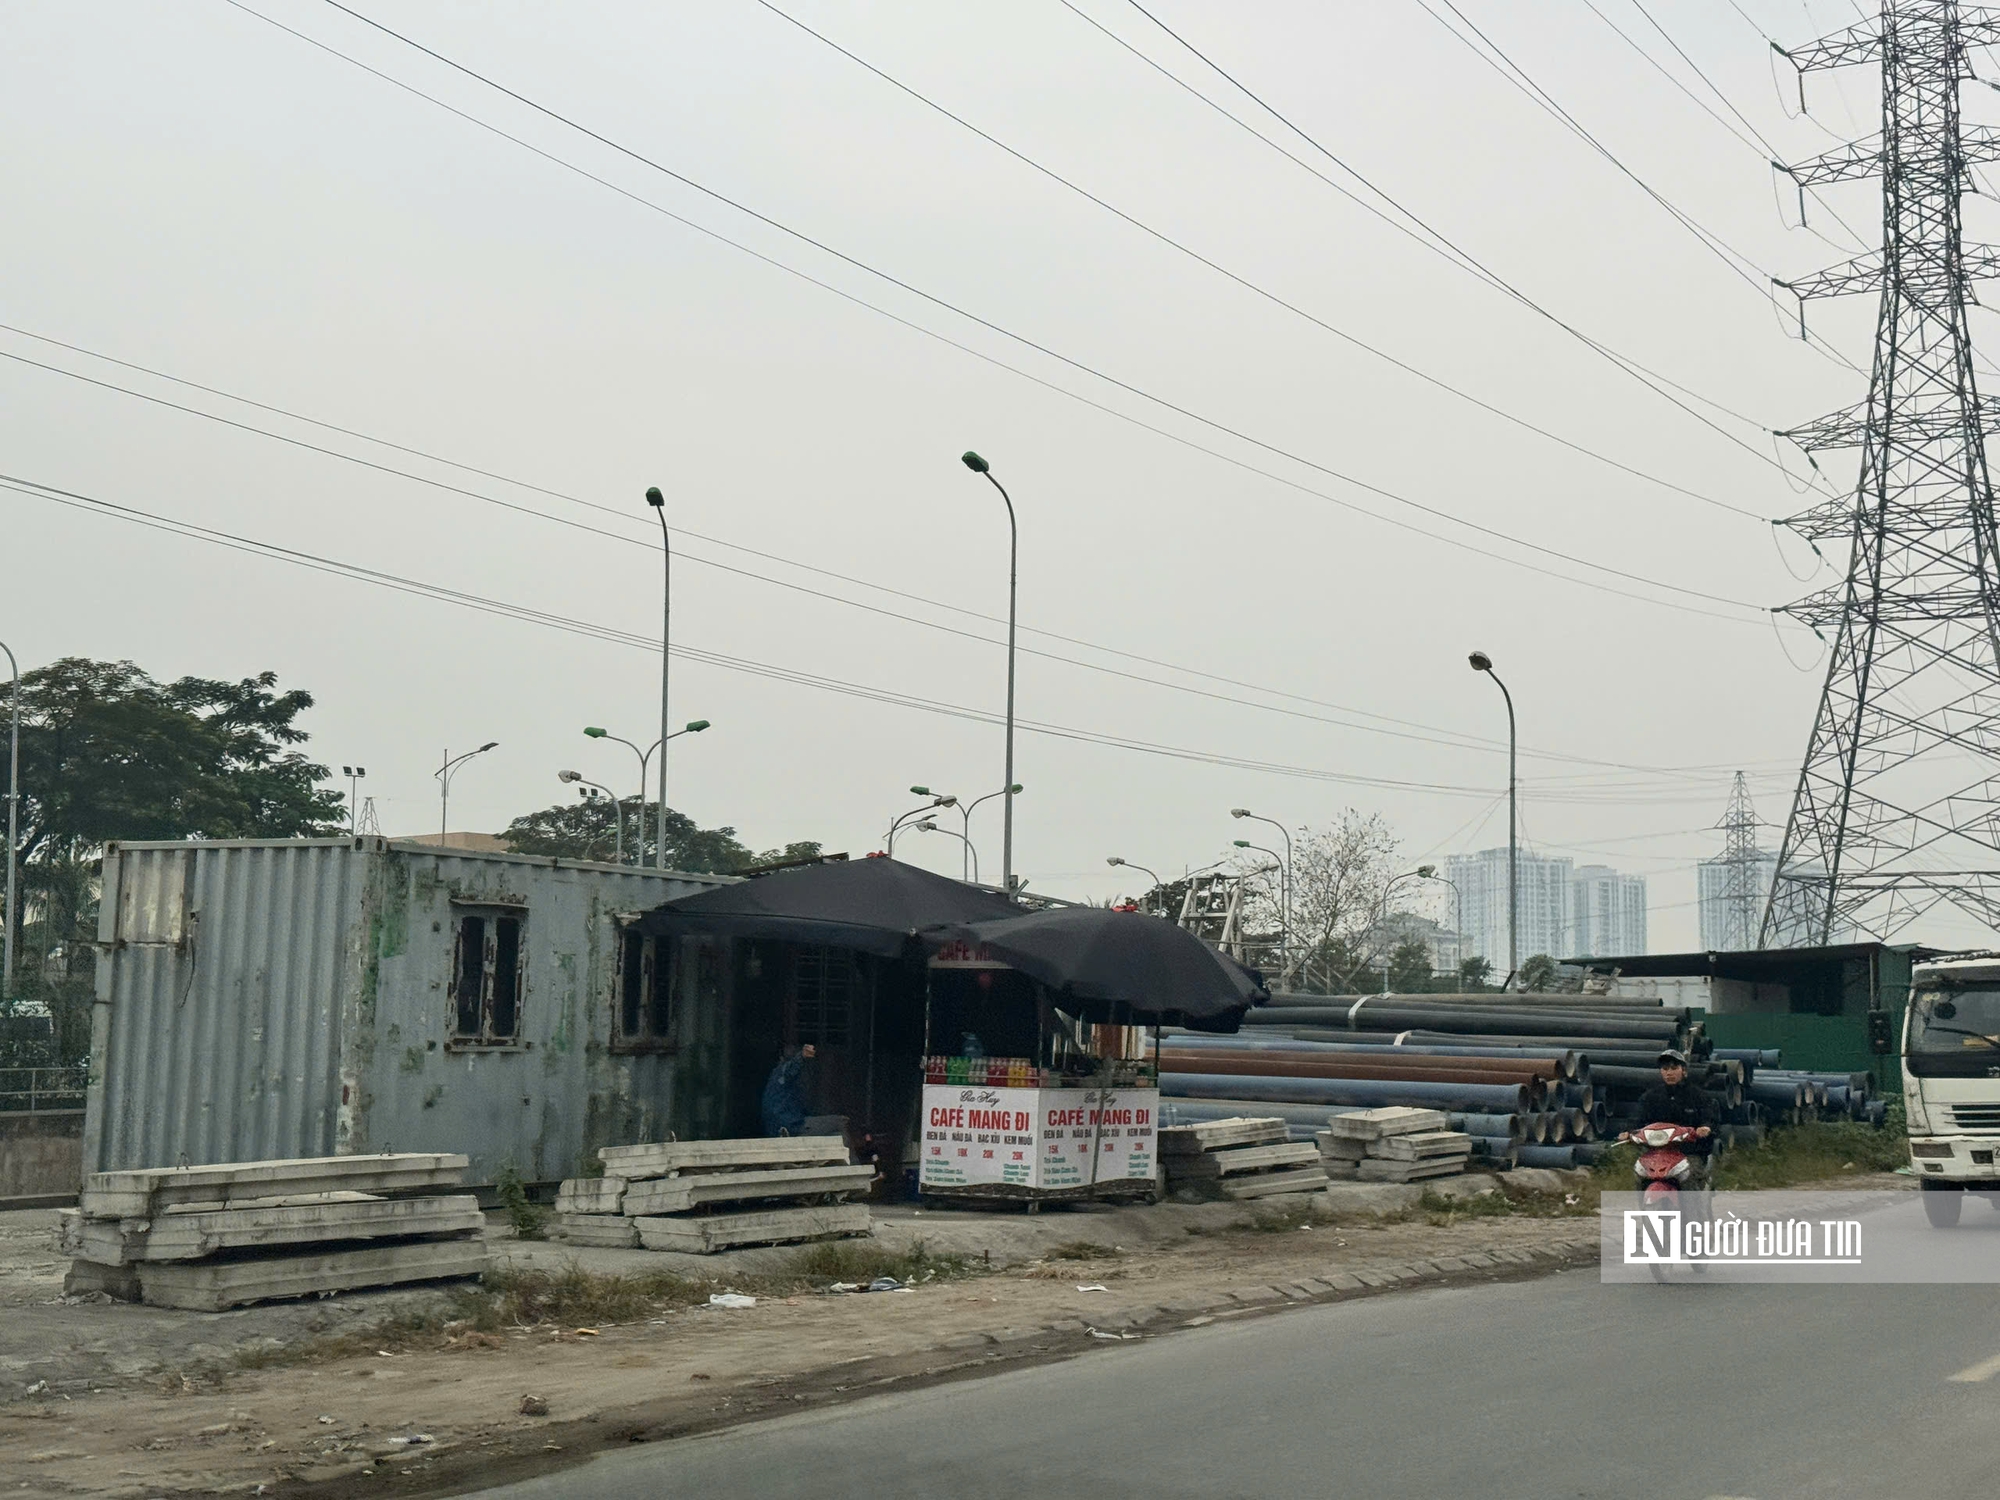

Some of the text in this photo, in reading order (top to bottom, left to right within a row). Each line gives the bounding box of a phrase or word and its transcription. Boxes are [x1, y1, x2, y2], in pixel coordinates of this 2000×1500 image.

[977, 1091, 1000, 1108] Huy
[930, 1105, 1030, 1132] CAFÉ MANG ĐI
[1048, 1106, 1149, 1126] CAFÉ MANG ĐI
[1004, 1135, 1017, 1145] KEM
